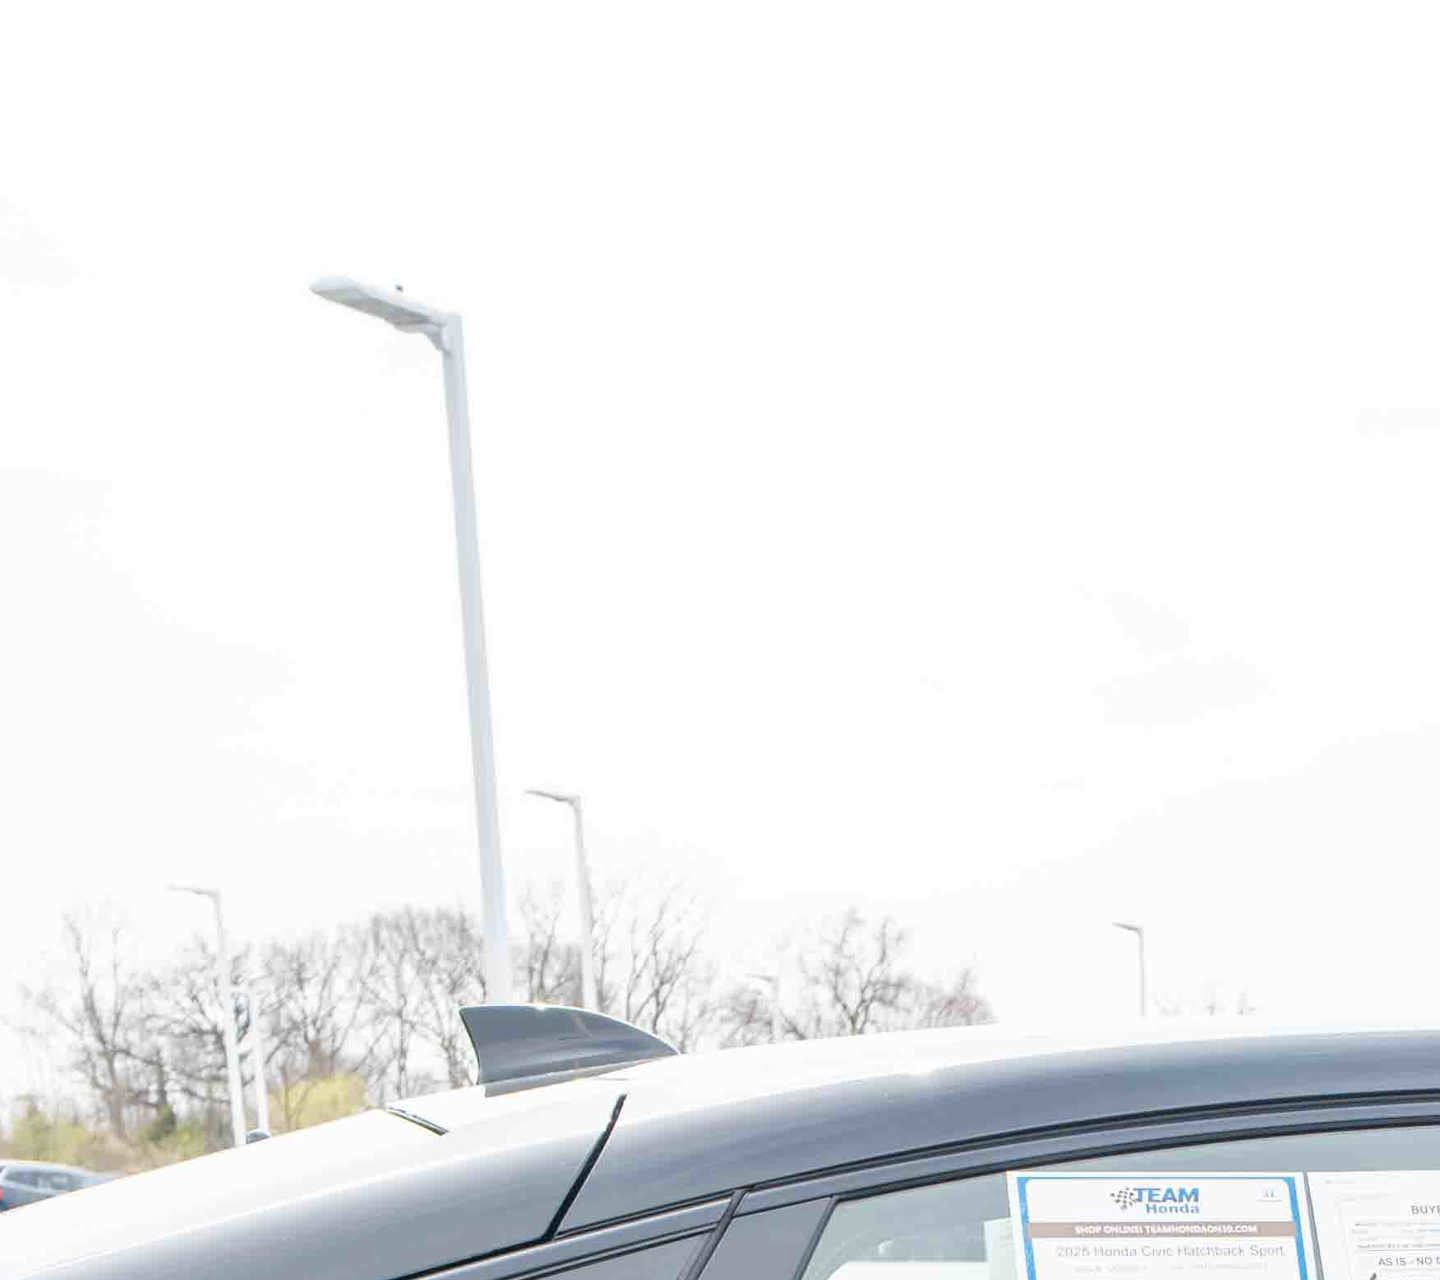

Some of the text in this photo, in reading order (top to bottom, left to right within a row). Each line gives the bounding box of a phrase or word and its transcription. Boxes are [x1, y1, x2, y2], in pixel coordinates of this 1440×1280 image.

[1133, 1187, 1200, 1203] TEAM
[1145, 1203, 1200, 1214] Honda
[1075, 1225, 1101, 1234] SHOP
[1094, 1245, 1137, 1257] Honda
[1141, 1244, 1171, 1257] Civic
[1177, 1244, 1244, 1256] Hatchback
[1250, 1243, 1285, 1258] Sport
[1378, 1256, 1394, 1267] AS
[1396, 1256, 1407, 1266] IS
[1417, 1256, 1431, 1266] NO
